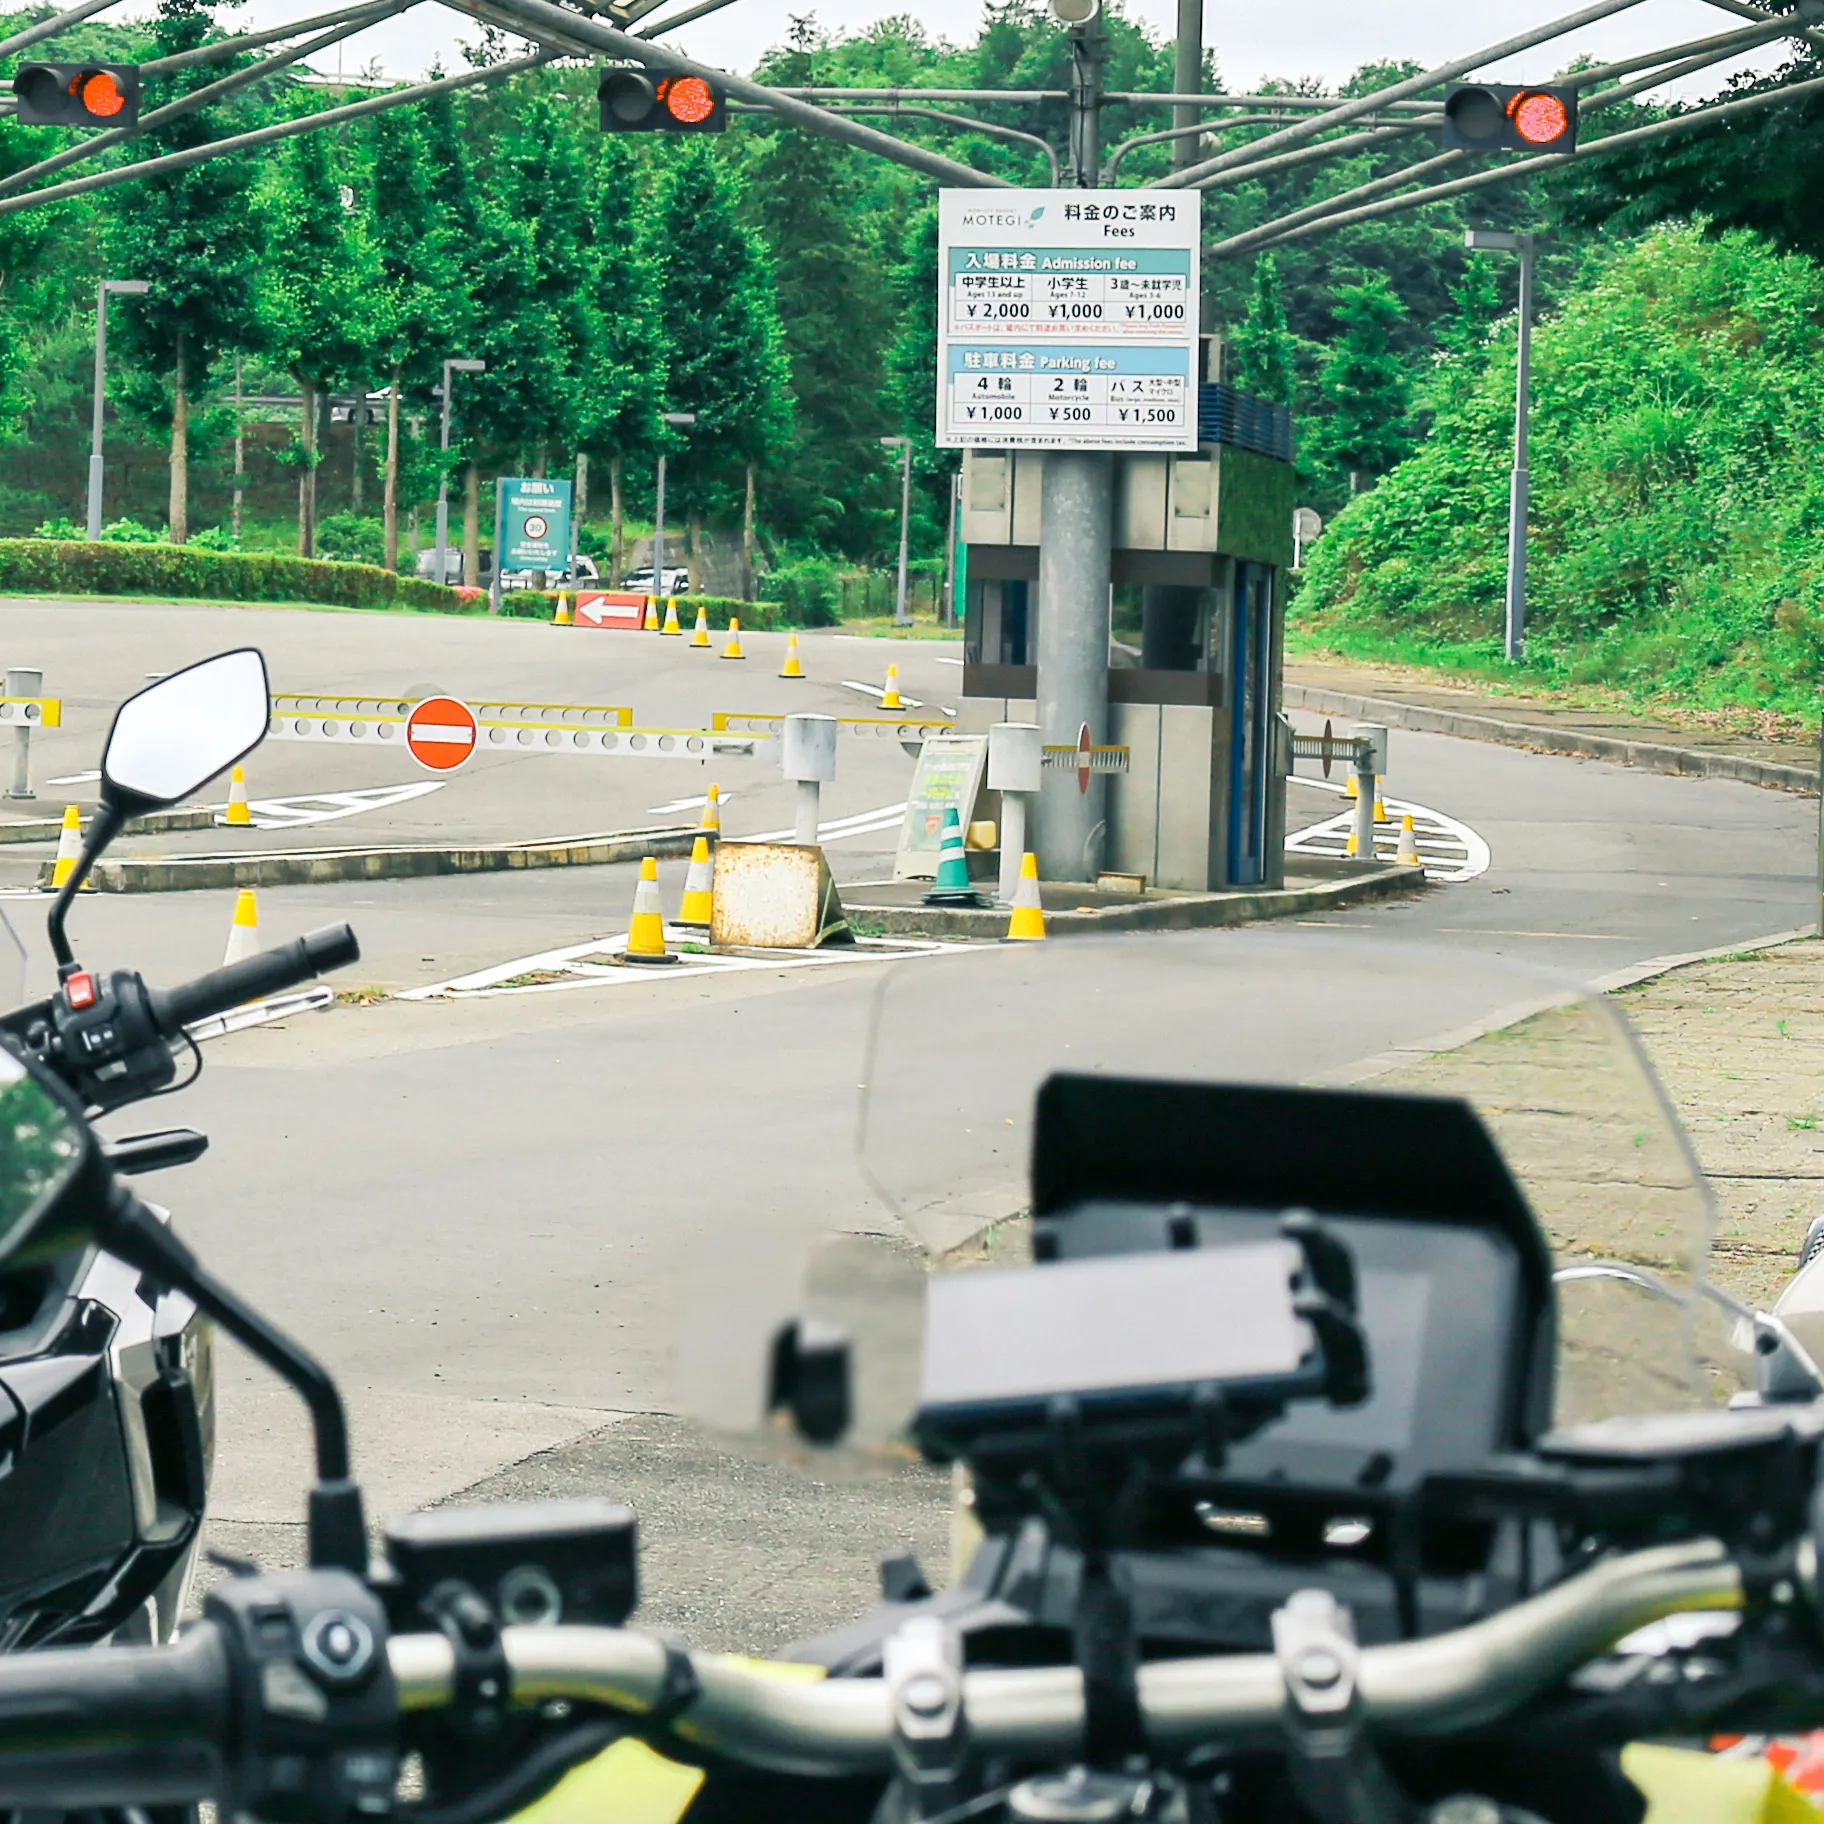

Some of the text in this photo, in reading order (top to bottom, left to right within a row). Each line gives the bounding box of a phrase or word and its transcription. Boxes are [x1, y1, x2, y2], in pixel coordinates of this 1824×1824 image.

[1064, 204, 1175, 221] 料金のご案内
[963, 215, 1021, 226] MOTEGI
[1104, 225, 1135, 237] Fees
[965, 253, 1036, 270] 入場料金
[1041, 256, 1136, 270] Admission fee
[962, 276, 1025, 288] 中学生以上
[1047, 277, 1088, 289] 小学生
[1049, 304, 1103, 319] ¥1,000
[1126, 305, 1184, 320] ¥1,000
[964, 352, 1036, 369] 駐車料金
[1040, 356, 1116, 372] Parking fee
[529, 524, 542, 532] 30
